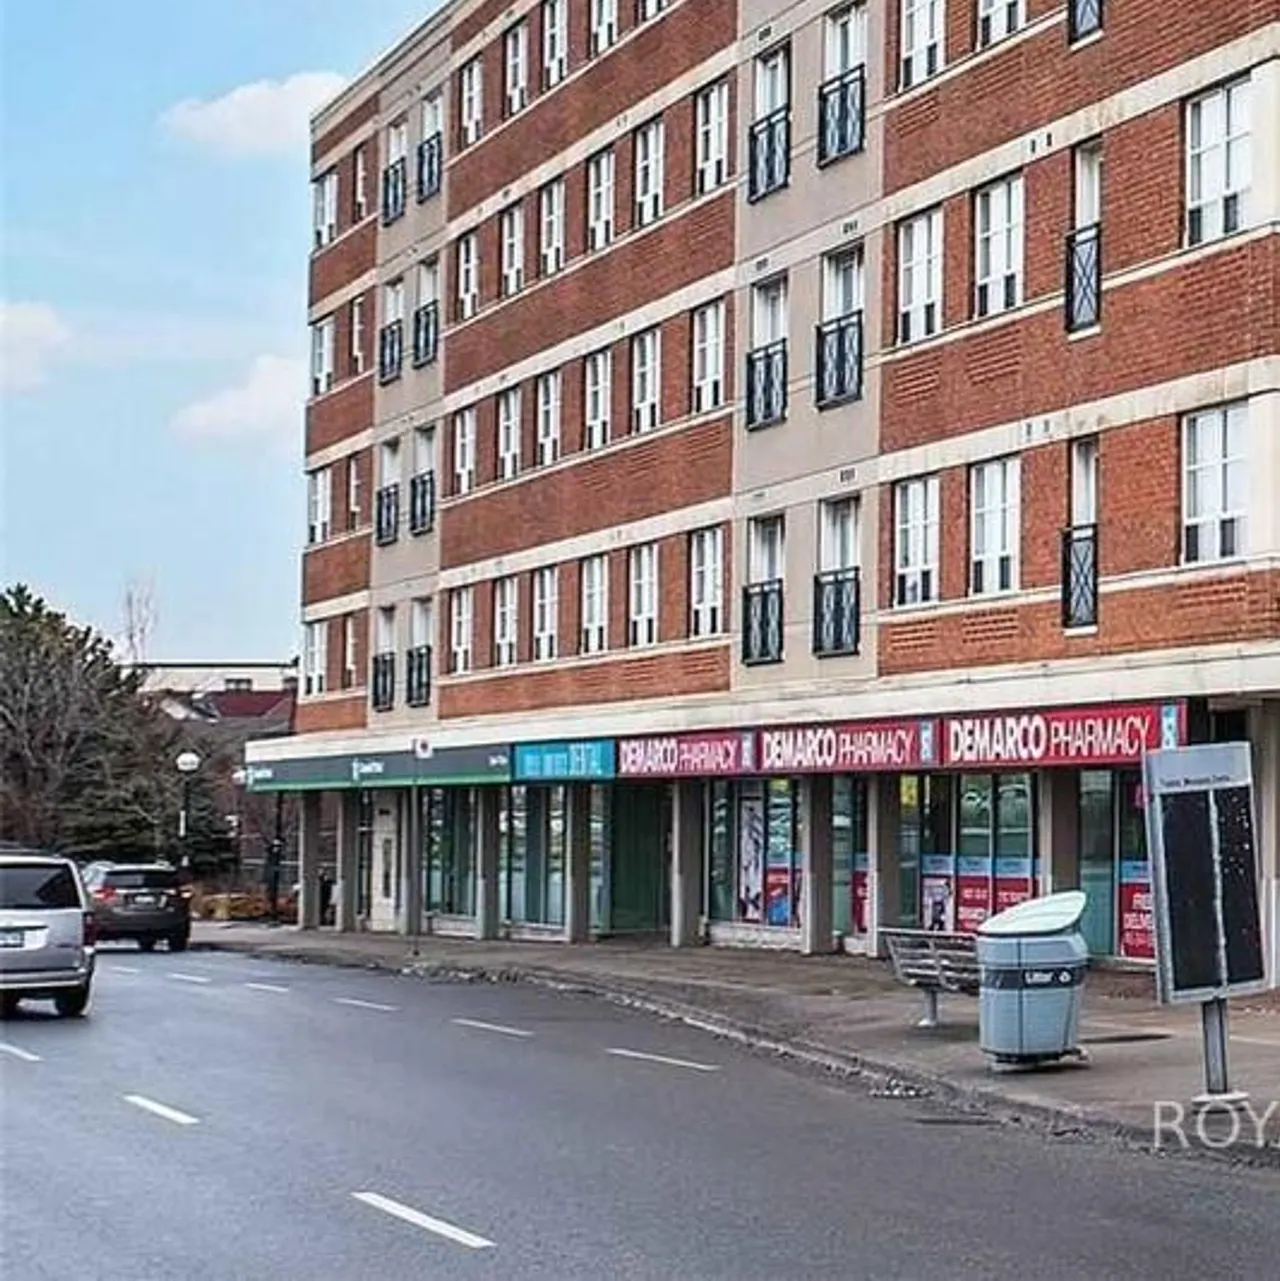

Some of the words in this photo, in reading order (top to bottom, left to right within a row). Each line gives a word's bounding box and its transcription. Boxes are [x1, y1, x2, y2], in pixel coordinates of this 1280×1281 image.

[618, 737, 678, 774] DEMARCO
[761, 728, 837, 769] DEMARCO
[838, 728, 916, 767] PHARMACY
[948, 713, 1047, 763] DEMARCO
[1050, 714, 1151, 758] PHARMACY
